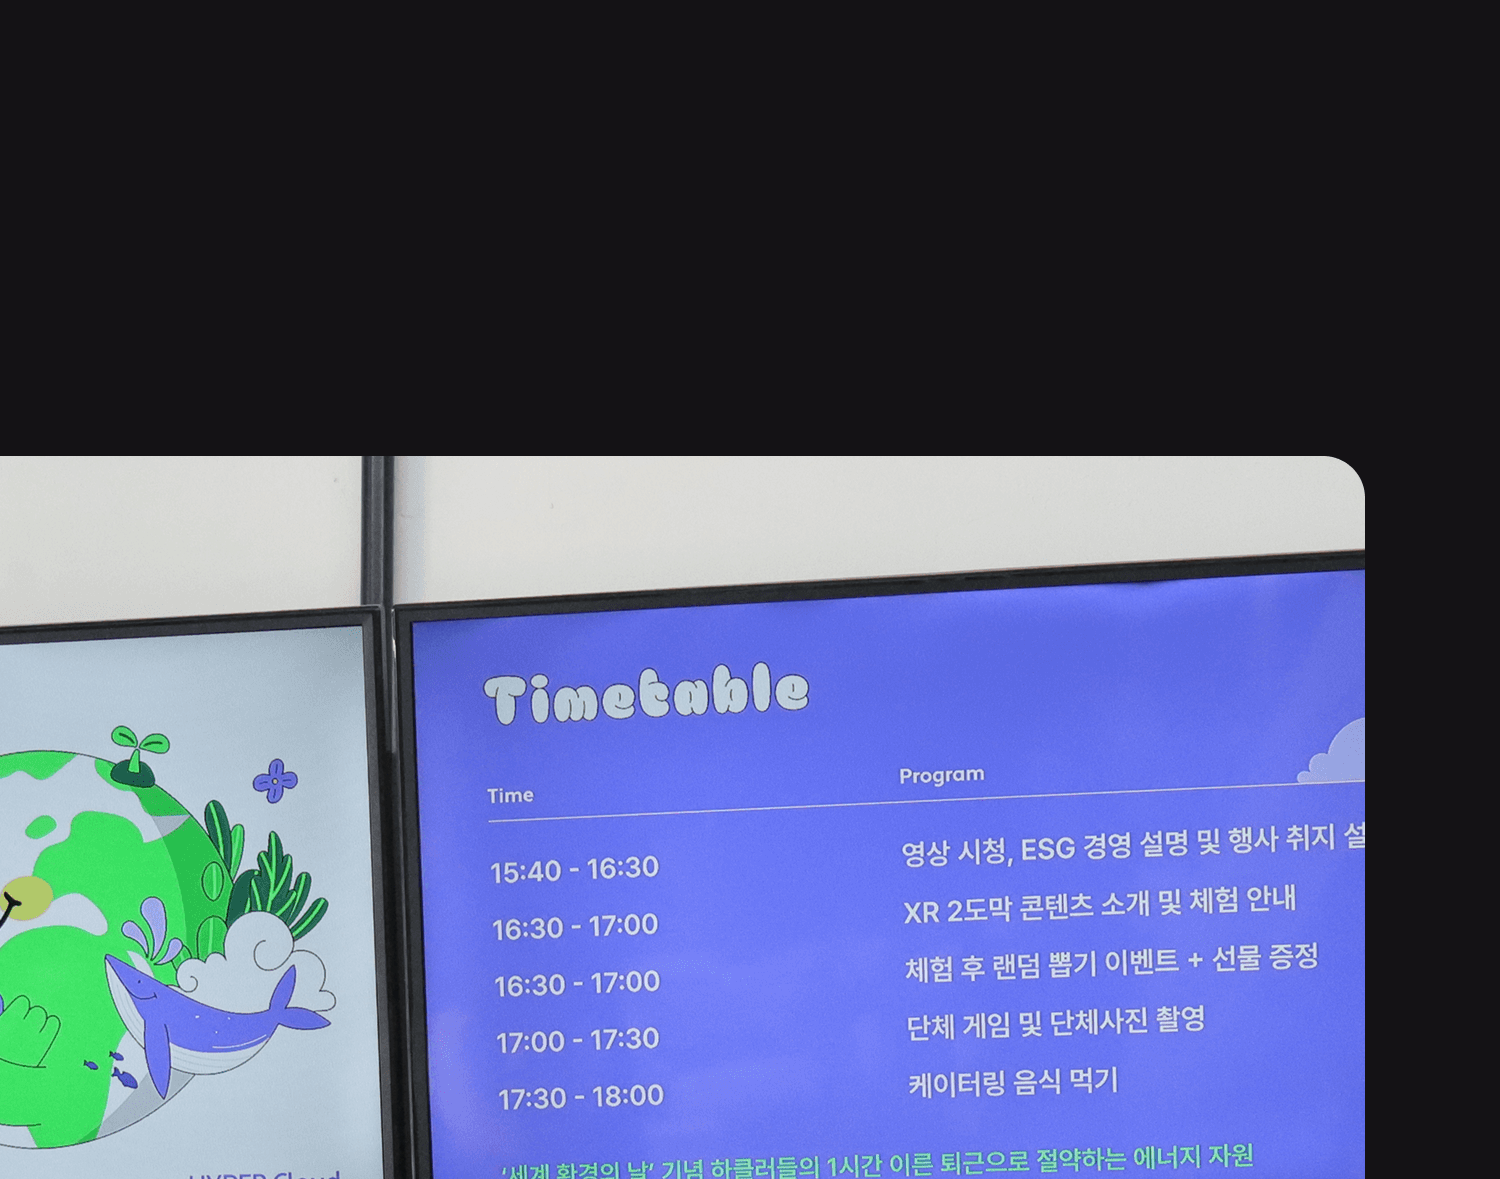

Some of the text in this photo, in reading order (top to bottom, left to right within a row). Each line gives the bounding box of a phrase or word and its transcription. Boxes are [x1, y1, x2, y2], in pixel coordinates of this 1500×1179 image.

[483, 661, 811, 726] Timetable
[899, 768, 985, 788] Program
[486, 787, 535, 804] Time
[901, 821, 1366, 868] 영상 시청, ESG 경영 설명 및 행사 취지 설
[490, 859, 563, 884] 15:40
[587, 855, 660, 880] 16:30
[903, 883, 1297, 925] XR 2도막 콘텐츠 소개 및 체험 안내
[492, 916, 565, 941] 16:30
[589, 912, 658, 937] 17:00
[905, 941, 1319, 984] 체험 후 랜덤 뽑기 이벤트 + 선물 증정
[494, 973, 567, 998] 16:30
[590, 969, 660, 994] 17:00
[907, 1004, 1205, 1042] 단체 게임 및 단체사진 촬영
[496, 1030, 565, 1054] 17:00
[590, 1026, 660, 1051] 17:30
[498, 1087, 567, 1111] 17:30
[592, 1083, 665, 1108] 18:00
[908, 1066, 1119, 1099] 케이터링 음식 먹기
[826, 1153, 885, 1179] 1시간
[889, 1152, 935, 1177] 이른
[940, 1150, 1031, 1176] 퇴근으로
[1036, 1147, 1129, 1174] 절약하는
[1133, 1144, 1202, 1170] 에너지
[1208, 1142, 1255, 1168] 자원
